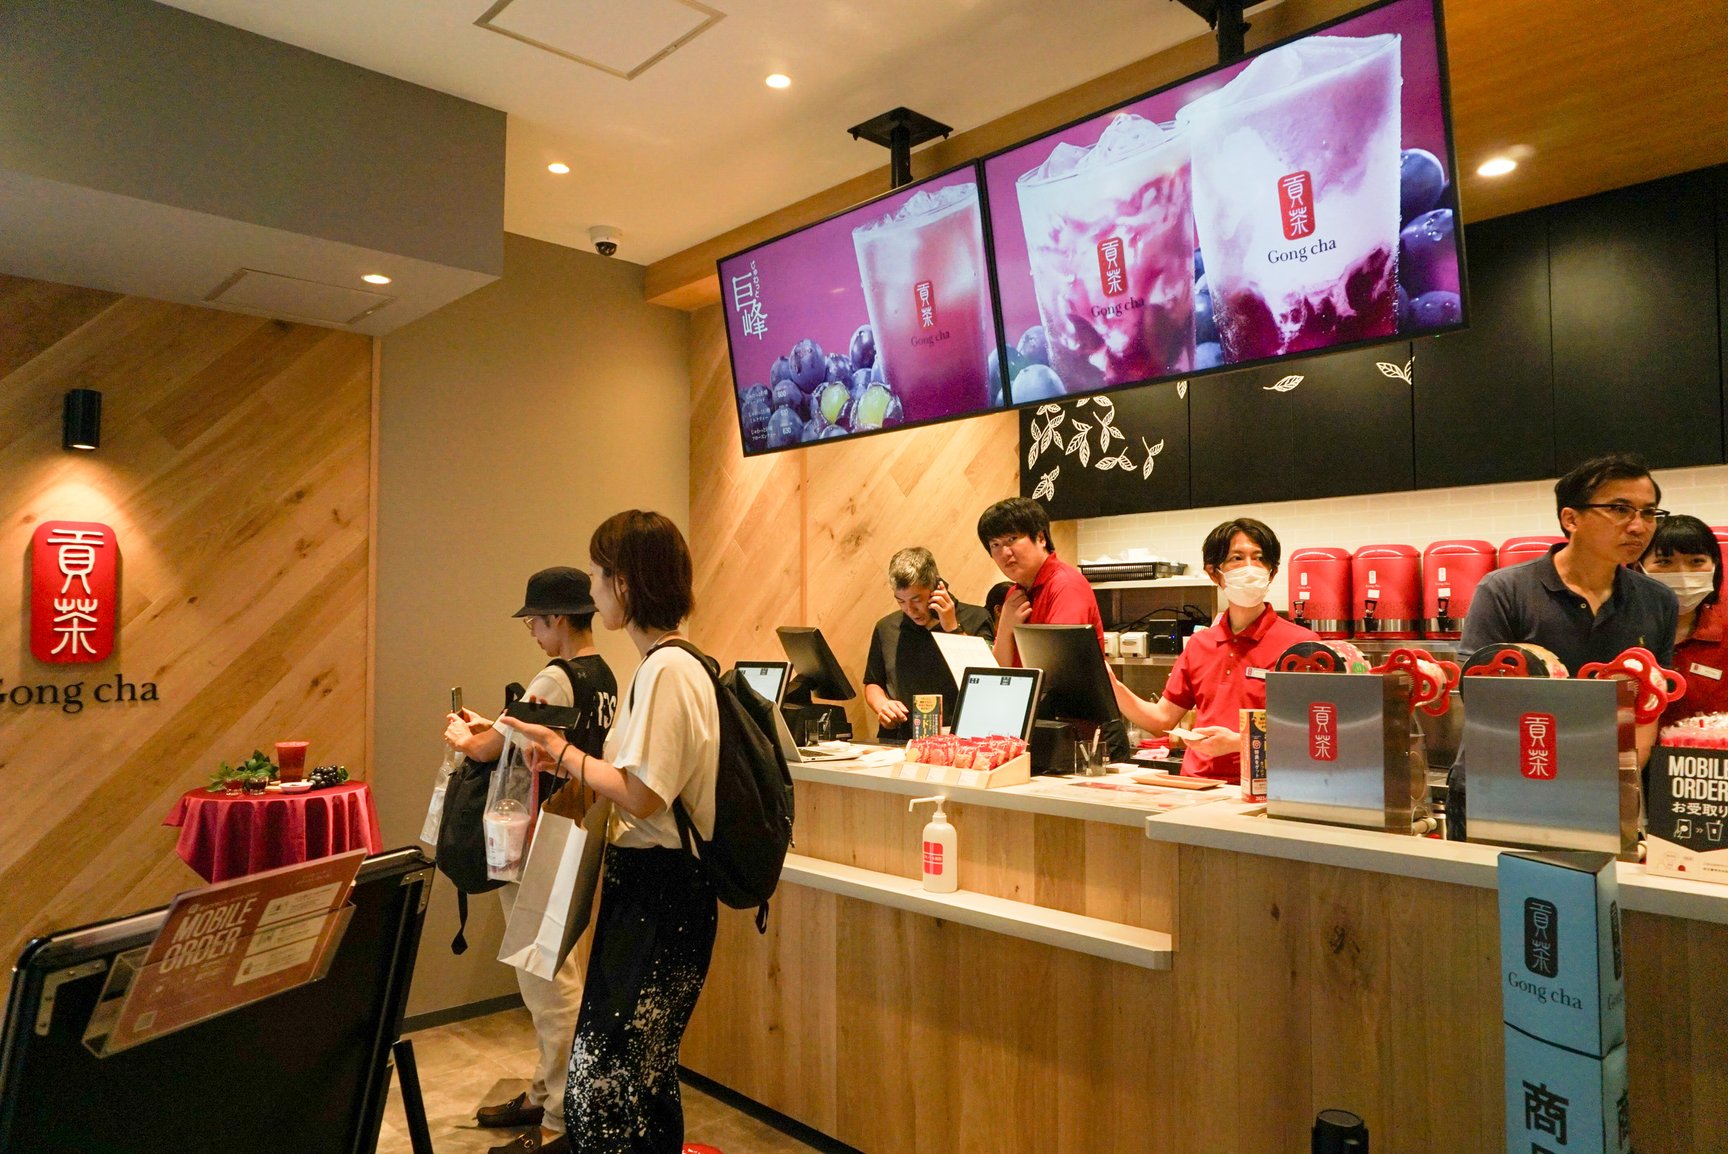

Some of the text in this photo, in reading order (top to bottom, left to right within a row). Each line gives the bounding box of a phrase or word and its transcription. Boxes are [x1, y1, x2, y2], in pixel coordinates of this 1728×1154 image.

[1267, 239, 1337, 264] Gong cha
[732, 272, 768, 340] 巨峰
[1091, 297, 1145, 318] Gong cha
[911, 330, 950, 348] Gong cha
[47, 528, 105, 654] 貢茶
[93, 673, 159, 703] cha
[1312, 705, 1332, 759] 貢茶
[1524, 716, 1550, 776] 貢茶
[1672, 777, 1728, 802] ORDER
[171, 897, 259, 944] MOBILE
[1529, 902, 1552, 974] 貢茶
[158, 926, 243, 974] ORDER
[1508, 971, 1547, 1004] Gong
[1550, 988, 1583, 1010] cha
